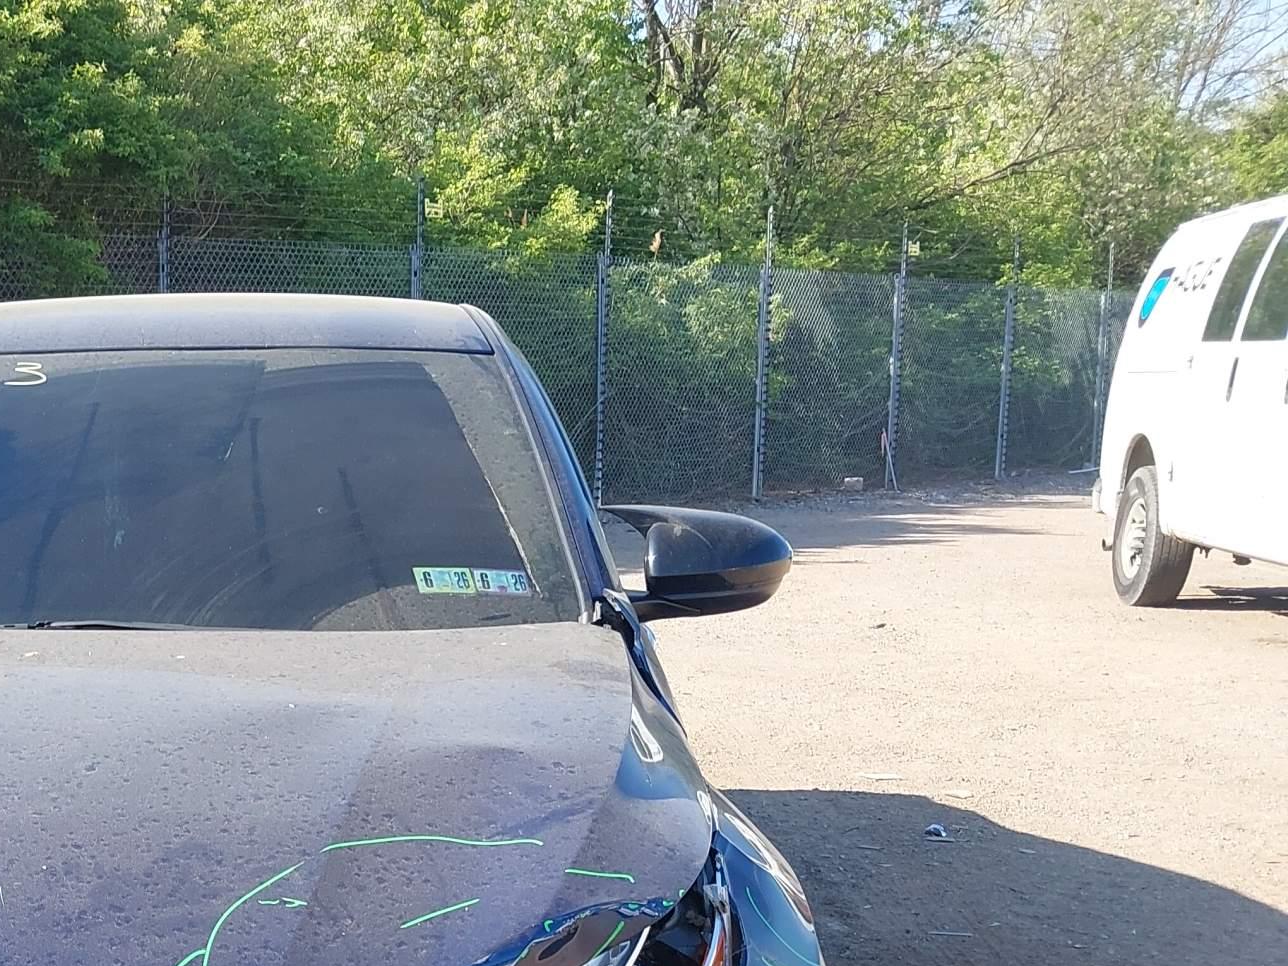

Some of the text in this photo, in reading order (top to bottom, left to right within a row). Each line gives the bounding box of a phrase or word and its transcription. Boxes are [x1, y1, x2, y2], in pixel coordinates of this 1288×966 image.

[422, 571, 470, 589] 6 26
[480, 572, 527, 591] 6 26
